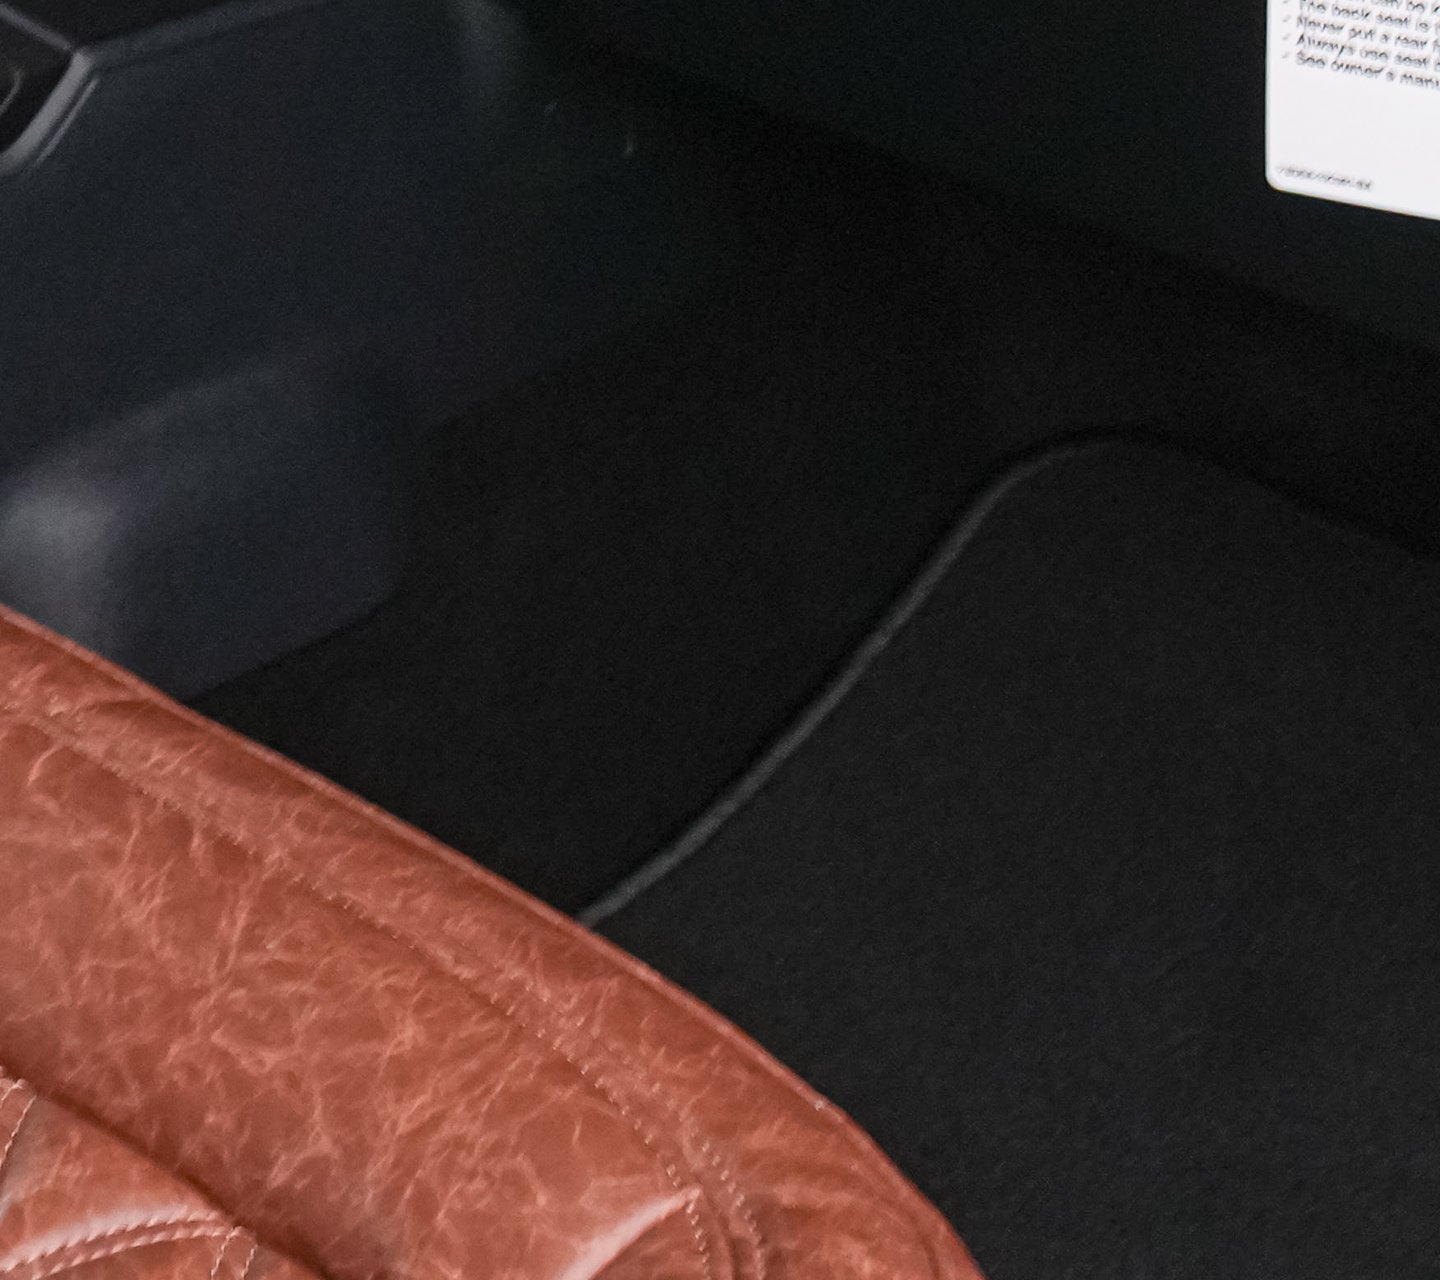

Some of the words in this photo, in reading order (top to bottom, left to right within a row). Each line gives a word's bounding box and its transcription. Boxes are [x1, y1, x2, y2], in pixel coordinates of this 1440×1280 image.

[1296, 15, 1343, 37] Never
[1348, 25, 1374, 44] put
[1380, 34, 1389, 45] a
[1395, 35, 1426, 52] rear
[1332, 3, 1368, 22] back
[1376, 12, 1408, 29] seat
[1415, 19, 1429, 33] is
[1296, 33, 1354, 59] Always
[1360, 47, 1387, 63] use
[1394, 51, 1428, 70] seat
[1296, 52, 1324, 69] See
